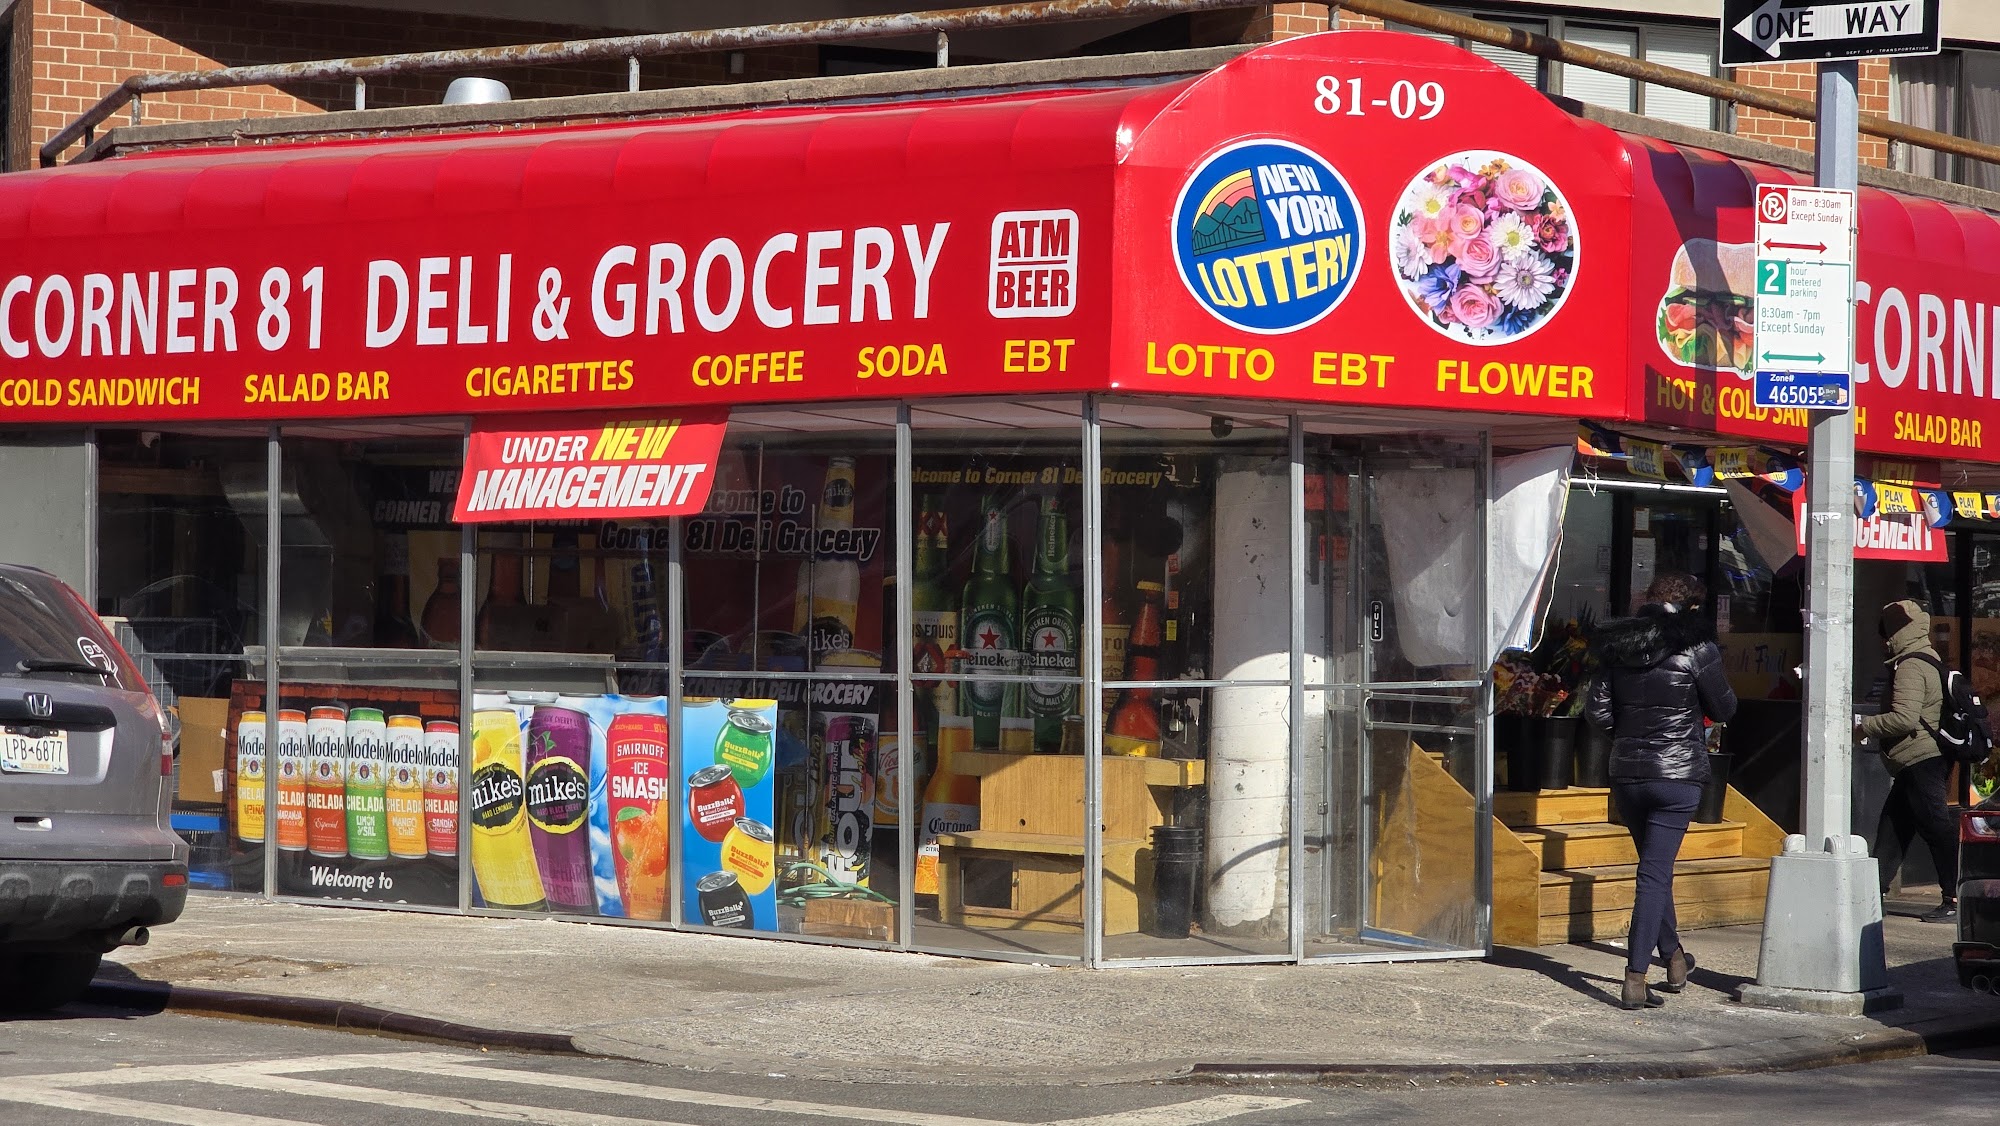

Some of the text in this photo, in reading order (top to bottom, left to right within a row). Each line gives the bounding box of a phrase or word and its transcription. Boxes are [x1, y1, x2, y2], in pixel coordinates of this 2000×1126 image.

[1756, 4, 1911, 41] ONE WAY
[1313, 75, 1445, 121] 81-09
[1256, 163, 1320, 196] NEW
[1265, 194, 1344, 240] YORK
[1791, 211, 1843, 224] Except Sunday
[1792, 197, 1807, 207] 8am
[1814, 199, 1841, 209] 8:30am
[998, 218, 1070, 259] ATM
[1196, 233, 1351, 309] LOTTERY
[1764, 263, 1807, 292] 2 hour
[1791, 278, 1821, 287] metered
[0, 222, 951, 358] CORNER 81 DELI & GROCERY
[995, 269, 1070, 309] BEER
[1791, 288, 1817, 299] parking
[1761, 308, 1793, 319] 8:30am
[1803, 310, 1820, 322] 7pm
[1761, 321, 1825, 336] Except Sunday
[692, 351, 804, 387] COFFEE
[857, 343, 948, 379] SODA
[1003, 338, 1076, 373] EBT
[1146, 341, 1276, 382] LOTTO
[1312, 351, 1395, 388] EBT
[0, 376, 200, 406] COLD SANDWICH
[244, 370, 390, 403] SALAD BAR
[465, 360, 634, 397] CIGARETTES
[1436, 359, 1595, 399] FLOWER
[1657, 375, 1697, 411] HOT
[1701, 385, 1716, 416] &
[502, 419, 682, 463] UNDER NEW
[1894, 410, 1982, 448] SALAD BAR
[1720, 452, 1740, 465] PLAY
[467, 464, 707, 511] MANAGEMENT
[965, 469, 980, 484] to
[985, 467, 1038, 484] Corner
[1100, 467, 1162, 489] Grocery
[1884, 490, 1904, 503] PLAY
[1958, 497, 1975, 508] PLAY
[601, 519, 670, 551] Corne
[776, 520, 880, 561] Grocery
[803, 682, 874, 706] GROCERY
[6, 738, 63, 762] LPB 6877
[279, 737, 307, 758] odelo
[308, 735, 345, 758] Modelo
[346, 736, 385, 760] Modelo
[386, 741, 423, 765] Modelo
[424, 745, 459, 768] Modelo
[617, 743, 665, 758] SMIRNOFF
[832, 740, 841, 772] PUNCH
[307, 792, 344, 811] CHELADA
[528, 776, 588, 806] mike's
[612, 776, 668, 800] SMASH
[830, 772, 839, 823] GALACTIC
[346, 794, 385, 812] CHELADA
[386, 799, 423, 814] CHELADA
[424, 798, 458, 814] CHELADA
[482, 801, 515, 820] HARD LEMONADE
[310, 865, 393, 892] Welcome to
